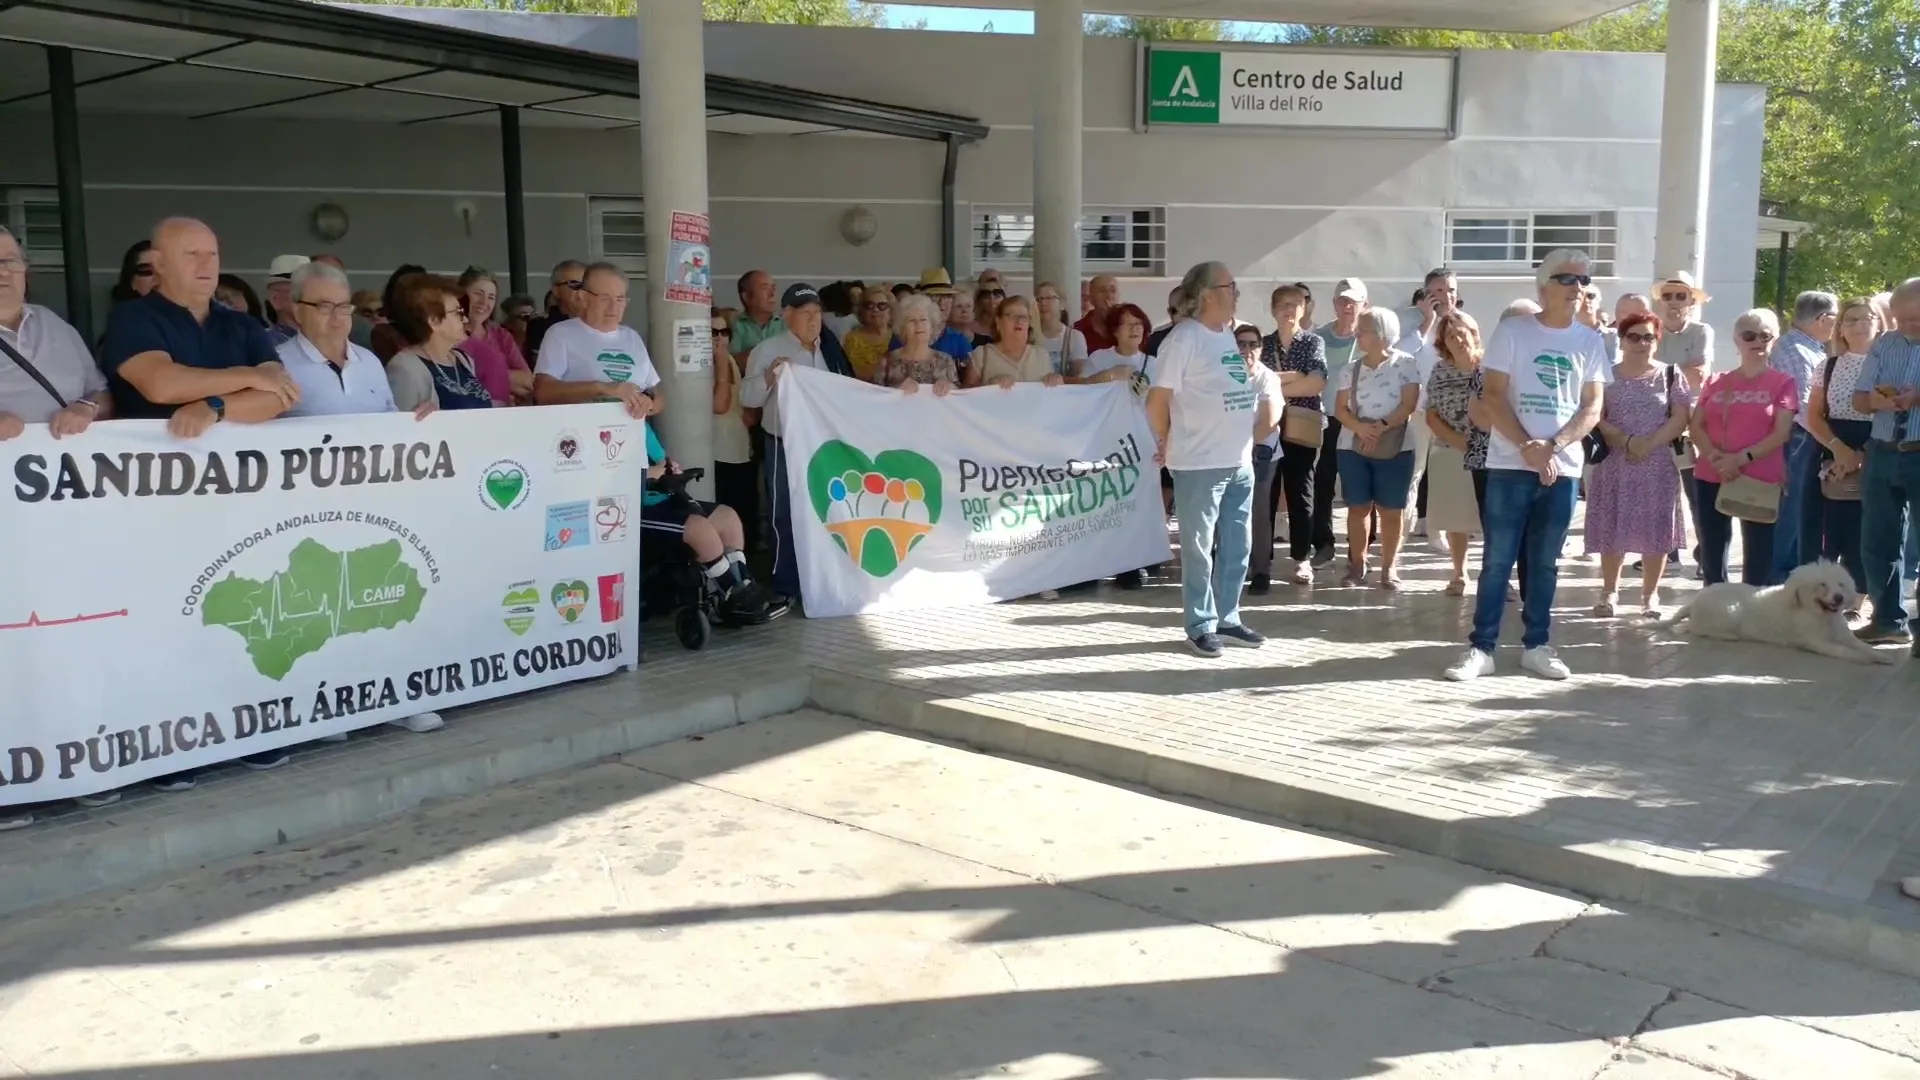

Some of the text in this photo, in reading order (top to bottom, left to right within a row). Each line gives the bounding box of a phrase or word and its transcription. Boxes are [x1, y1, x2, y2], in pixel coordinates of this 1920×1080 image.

[1233, 68, 1403, 92] Centro de Salud
[1232, 95, 1323, 112] Villa del Río
[14, 434, 456, 502] SANIDAD PÚBLICA
[960, 497, 990, 521] por
[972, 466, 1140, 533] su SANIDAD
[1009, 528, 1054, 546] NUESTRA
[1054, 518, 1086, 535] SALUD
[1103, 500, 1137, 518] MPRE
[1005, 538, 1066, 557] IMPORTANTE
[1067, 530, 1088, 545] PAR
[182, 510, 440, 616] COORDINADORA ANDALUZA DE MAREAS BLANCAS
[363, 584, 406, 602] CAMB
[56, 711, 226, 780] PÚBLICA
[232, 696, 302, 740] DEL
[310, 676, 400, 724] ÁREA
[406, 661, 464, 702] SUR
[472, 652, 509, 688] DE
